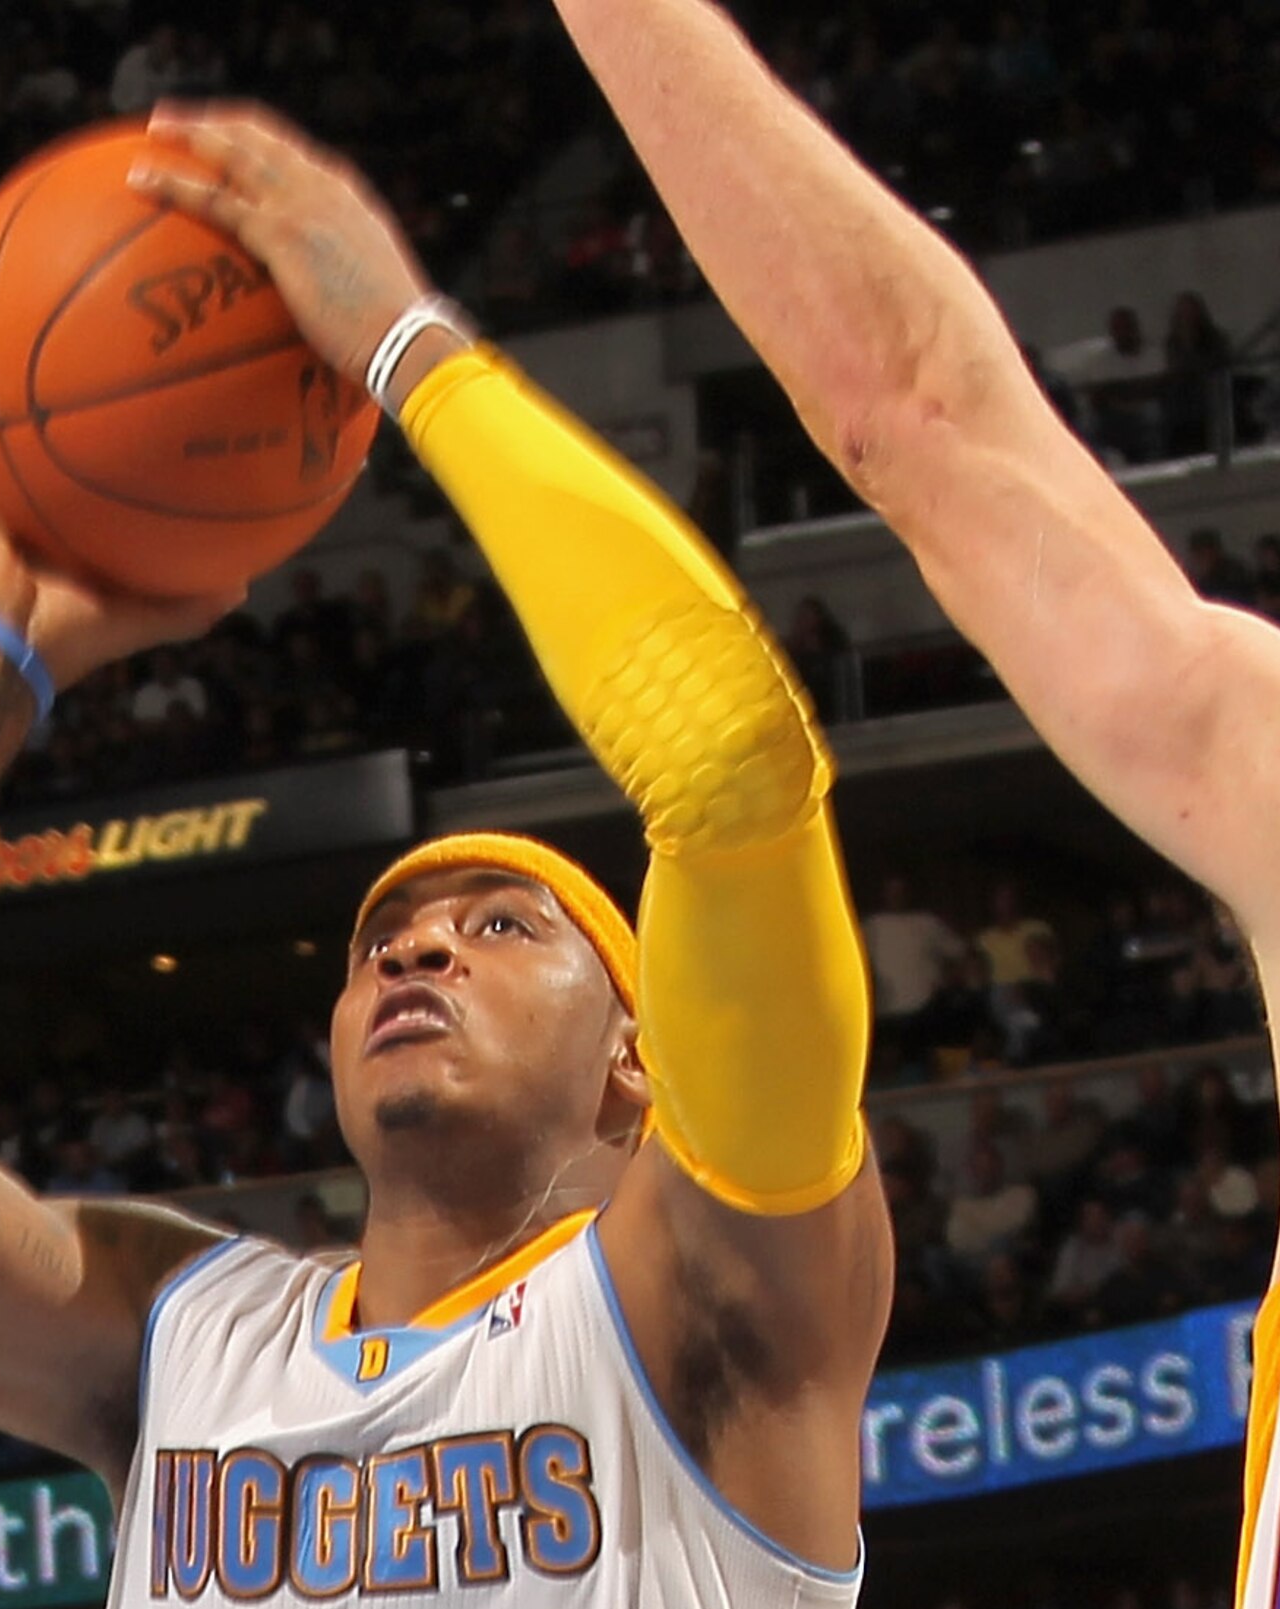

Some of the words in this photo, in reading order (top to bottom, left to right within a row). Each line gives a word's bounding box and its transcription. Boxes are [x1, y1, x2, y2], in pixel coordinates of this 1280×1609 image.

[97, 798, 268, 868] LIGHT
[357, 1337, 390, 1383] D
[861, 1350, 1197, 1485] reless
